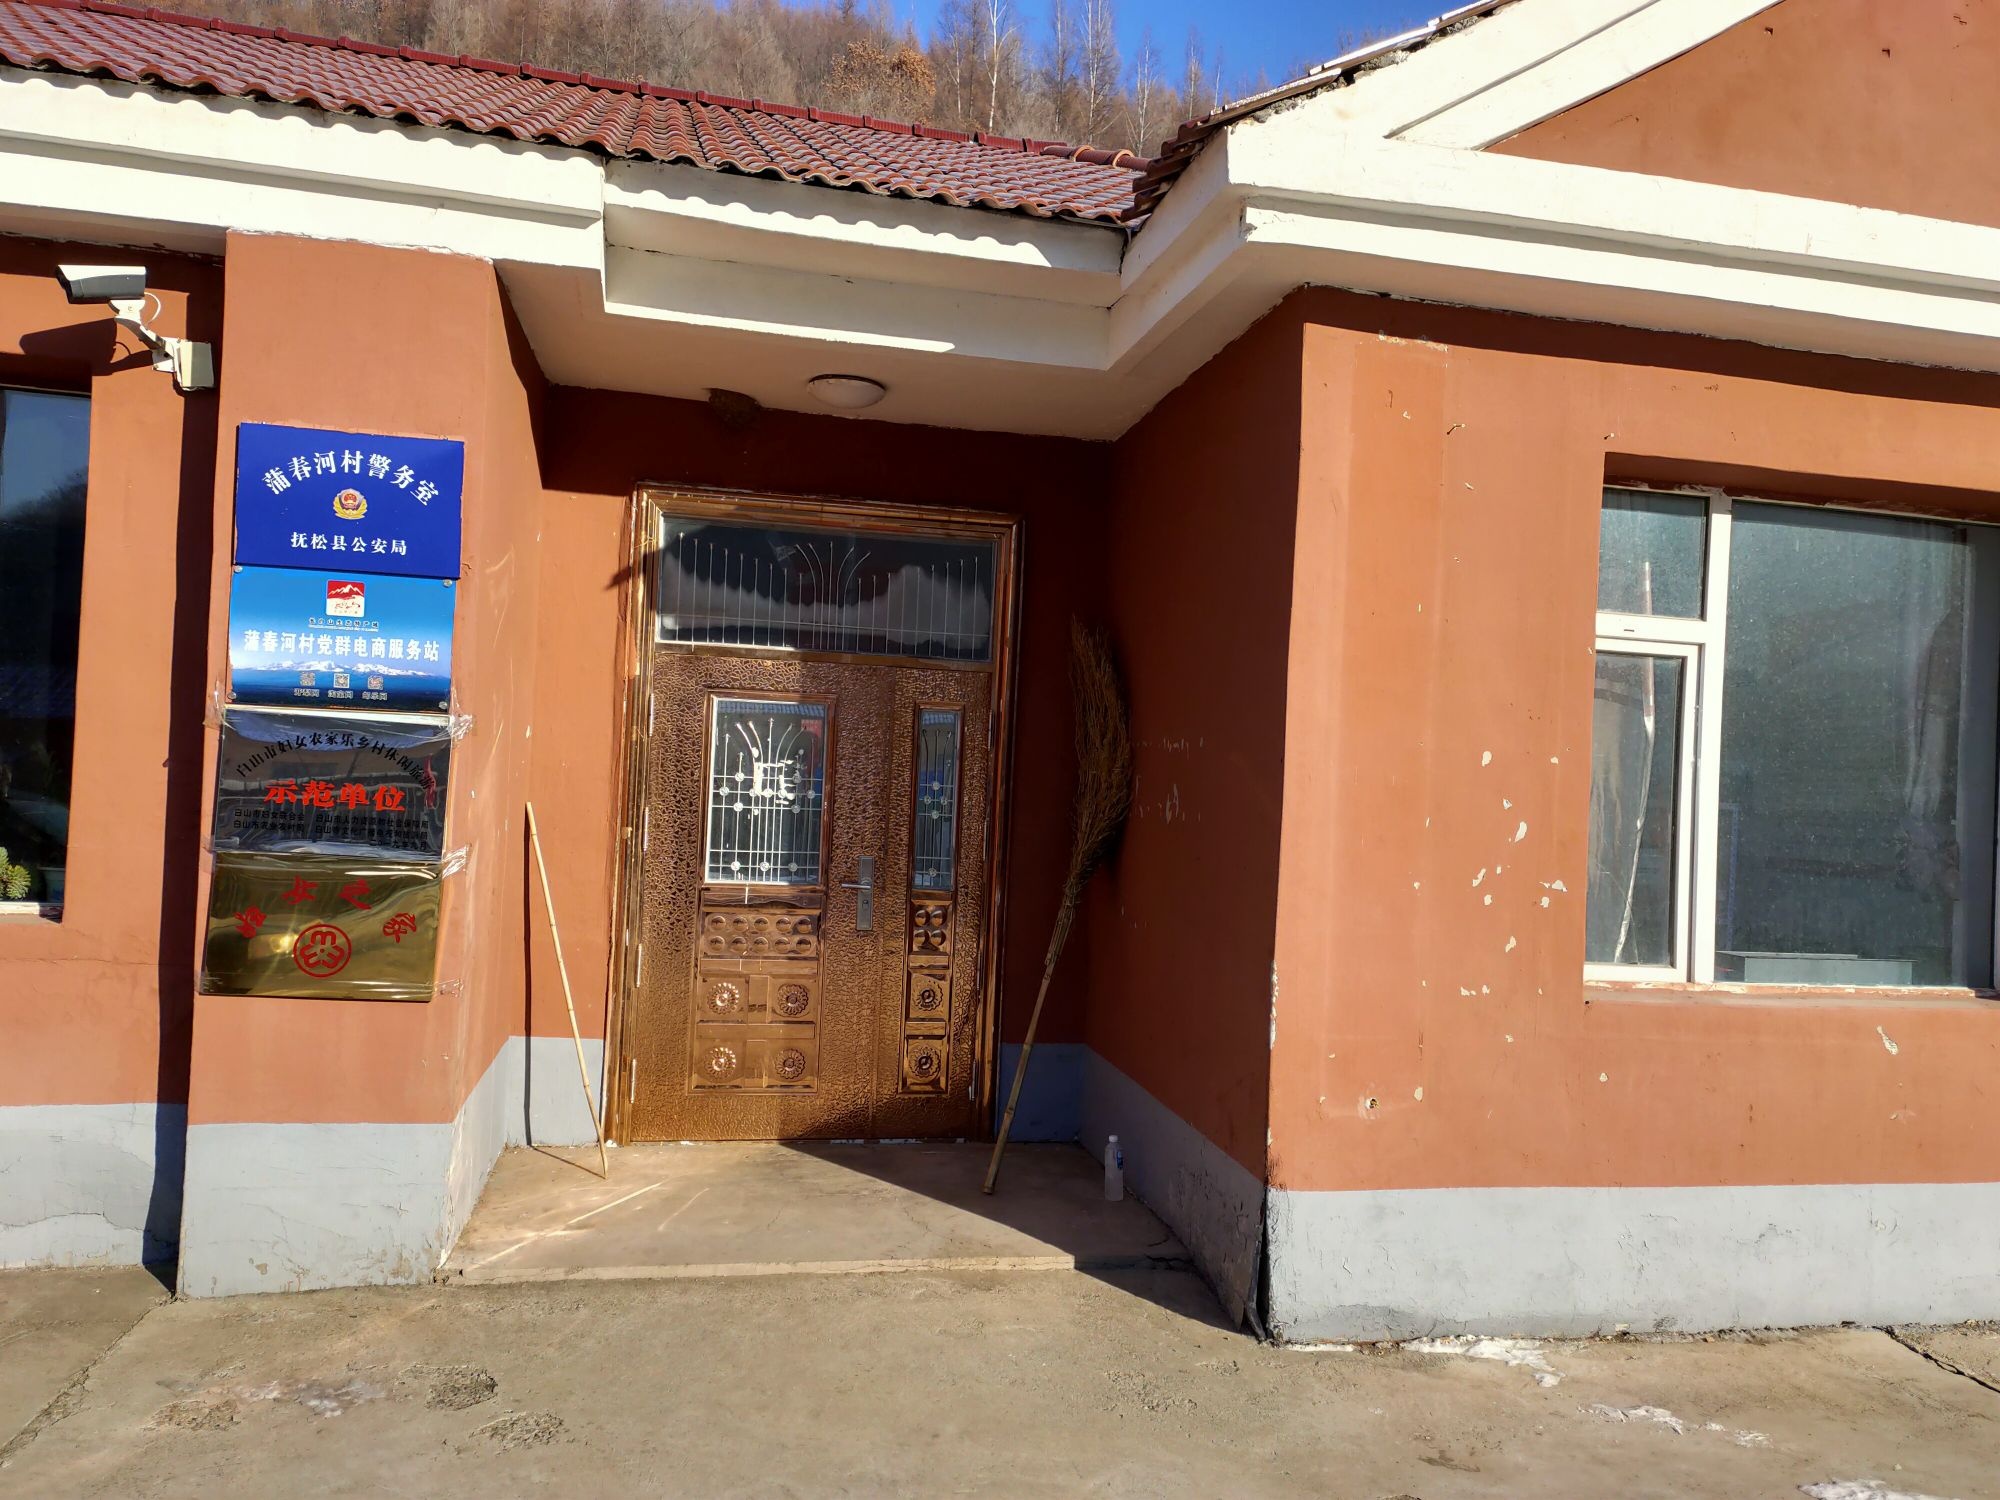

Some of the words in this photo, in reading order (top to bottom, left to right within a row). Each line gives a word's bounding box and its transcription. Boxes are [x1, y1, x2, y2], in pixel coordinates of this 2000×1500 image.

[262, 449, 439, 506] 蒲春河村警务室
[290, 532, 407, 556] 抚松县公安局
[244, 629, 440, 662] 蒲春河村党群电商服务站
[264, 779, 406, 811] 示范单位
